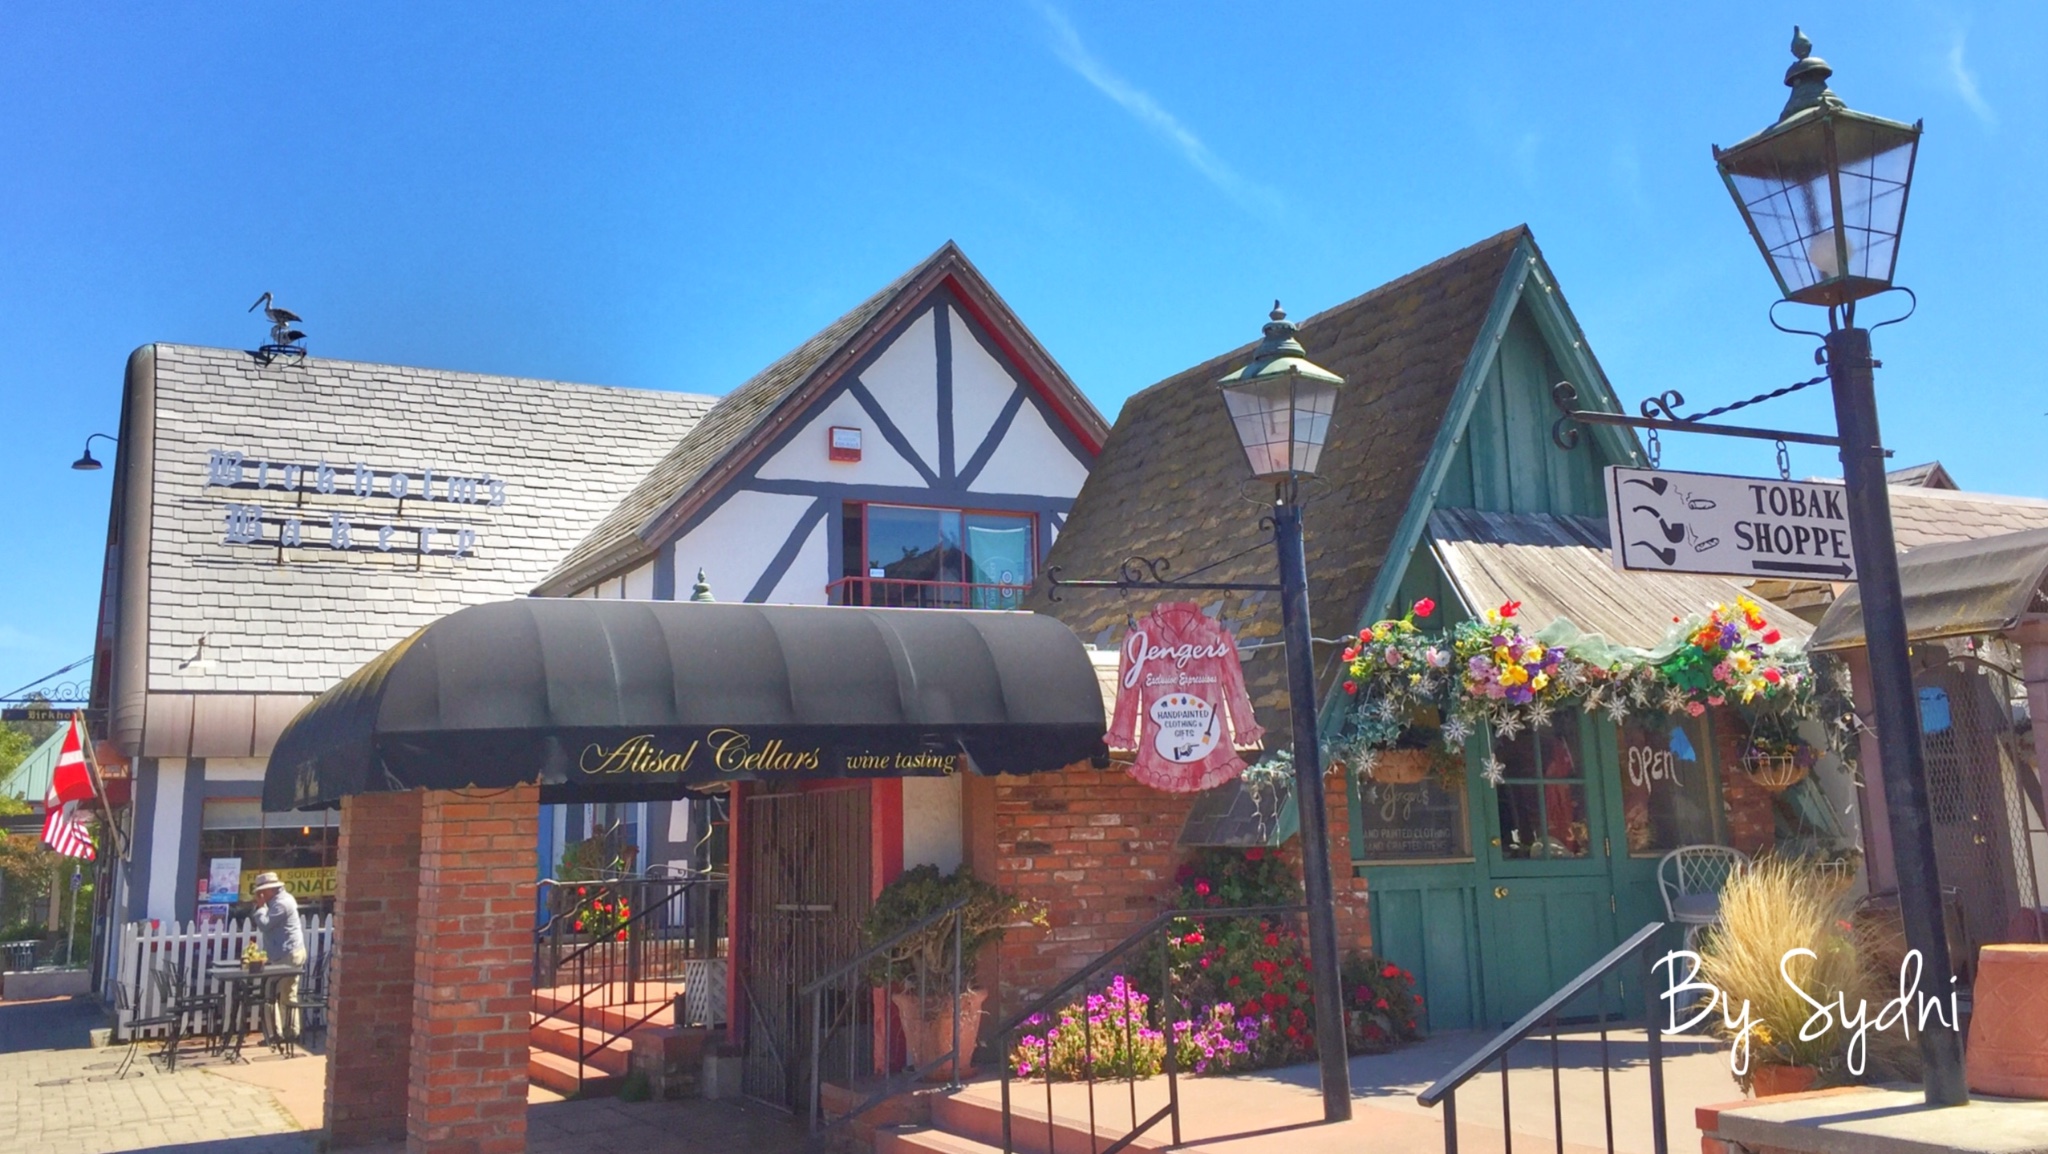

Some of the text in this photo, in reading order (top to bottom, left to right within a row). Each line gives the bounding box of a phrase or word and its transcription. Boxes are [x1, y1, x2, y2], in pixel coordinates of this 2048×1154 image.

[203, 448, 508, 508] Birkholm's
[1748, 484, 1845, 521] TOBAK
[221, 503, 476, 561] Bakery
[1734, 520, 1851, 560] SHOPPE
[1124, 631, 1230, 689] Jenger's
[27, 710, 71, 720] Birkho
[1157, 709, 1210, 720] HANDPAINTED
[1164, 719, 1198, 728] CLOTHING
[579, 727, 957, 775] Alisal Cellars wine tasting
[1174, 729, 1195, 738] GIFTS
[287, 869, 336, 880] SQUEEZE
